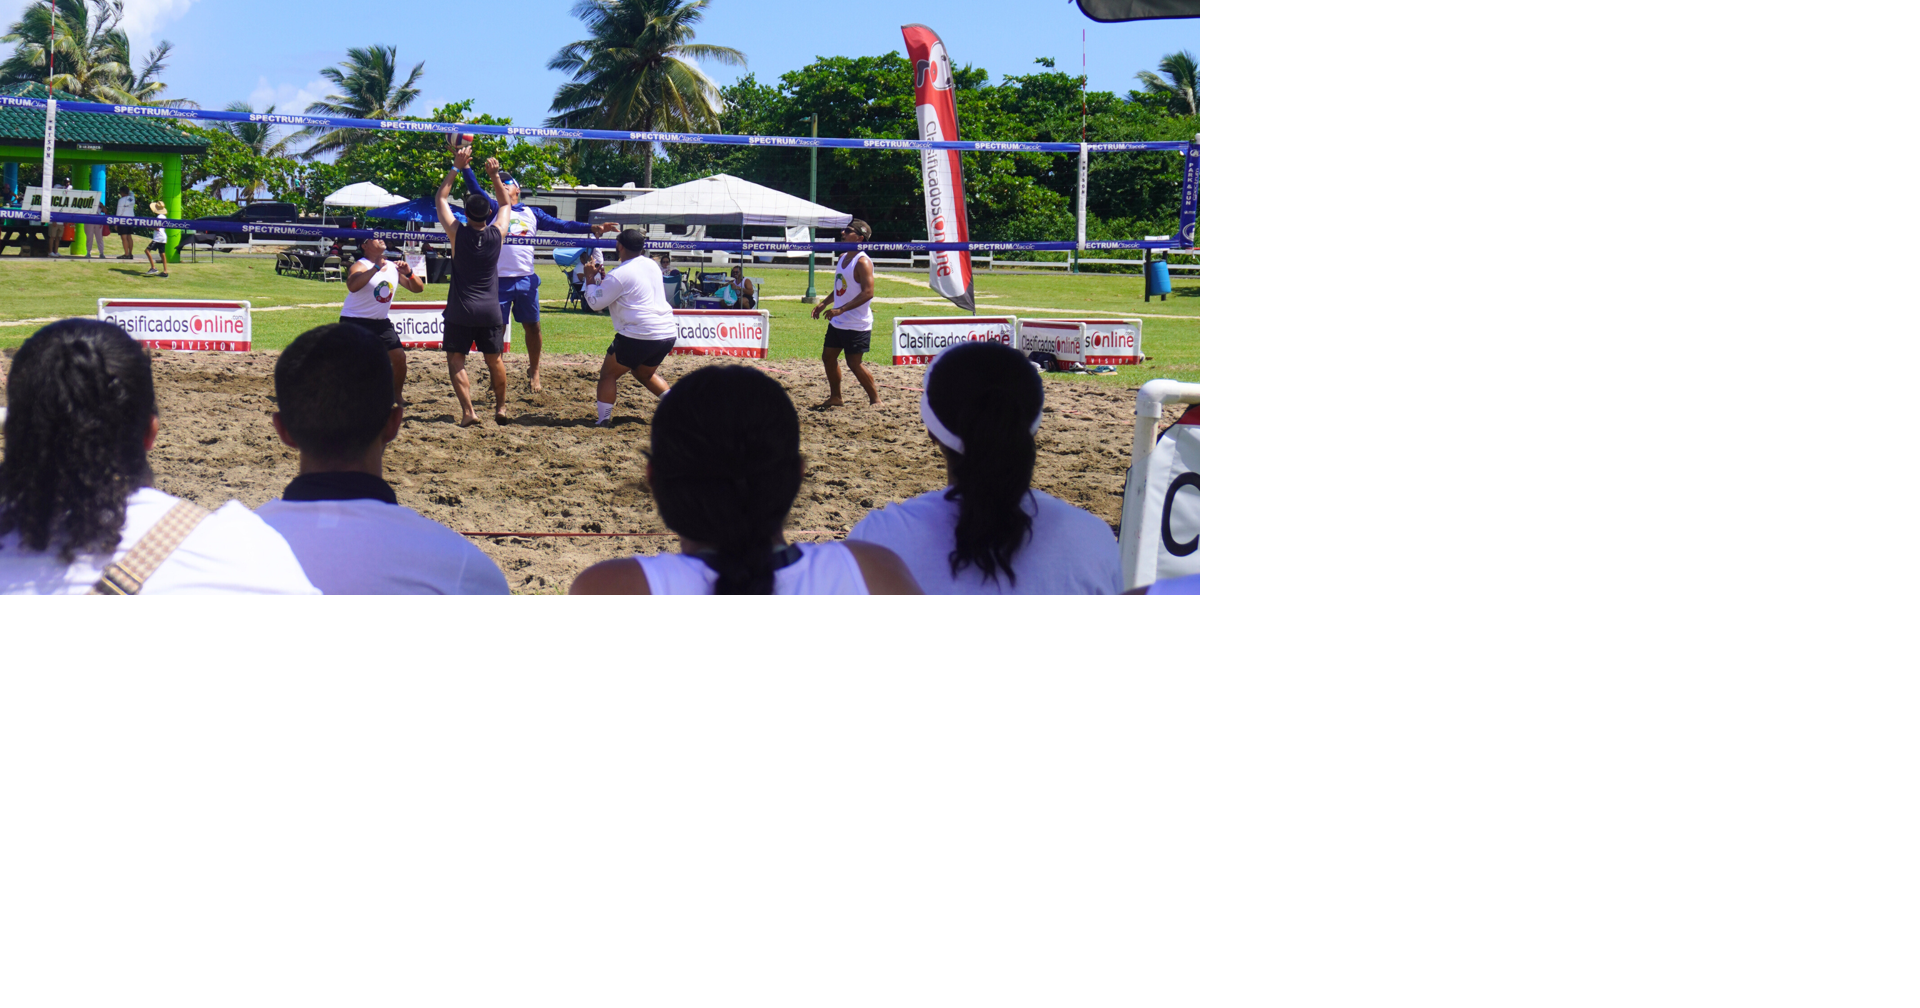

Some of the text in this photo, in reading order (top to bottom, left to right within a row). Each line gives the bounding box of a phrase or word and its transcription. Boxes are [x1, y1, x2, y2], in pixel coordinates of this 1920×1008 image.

[31, 194, 95, 209] ¡RICLA AQUÍ!
[676, 322, 763, 341] icadosOnline
[172, 341, 236, 351] DIVISION
[902, 356, 935, 365] SPOR
